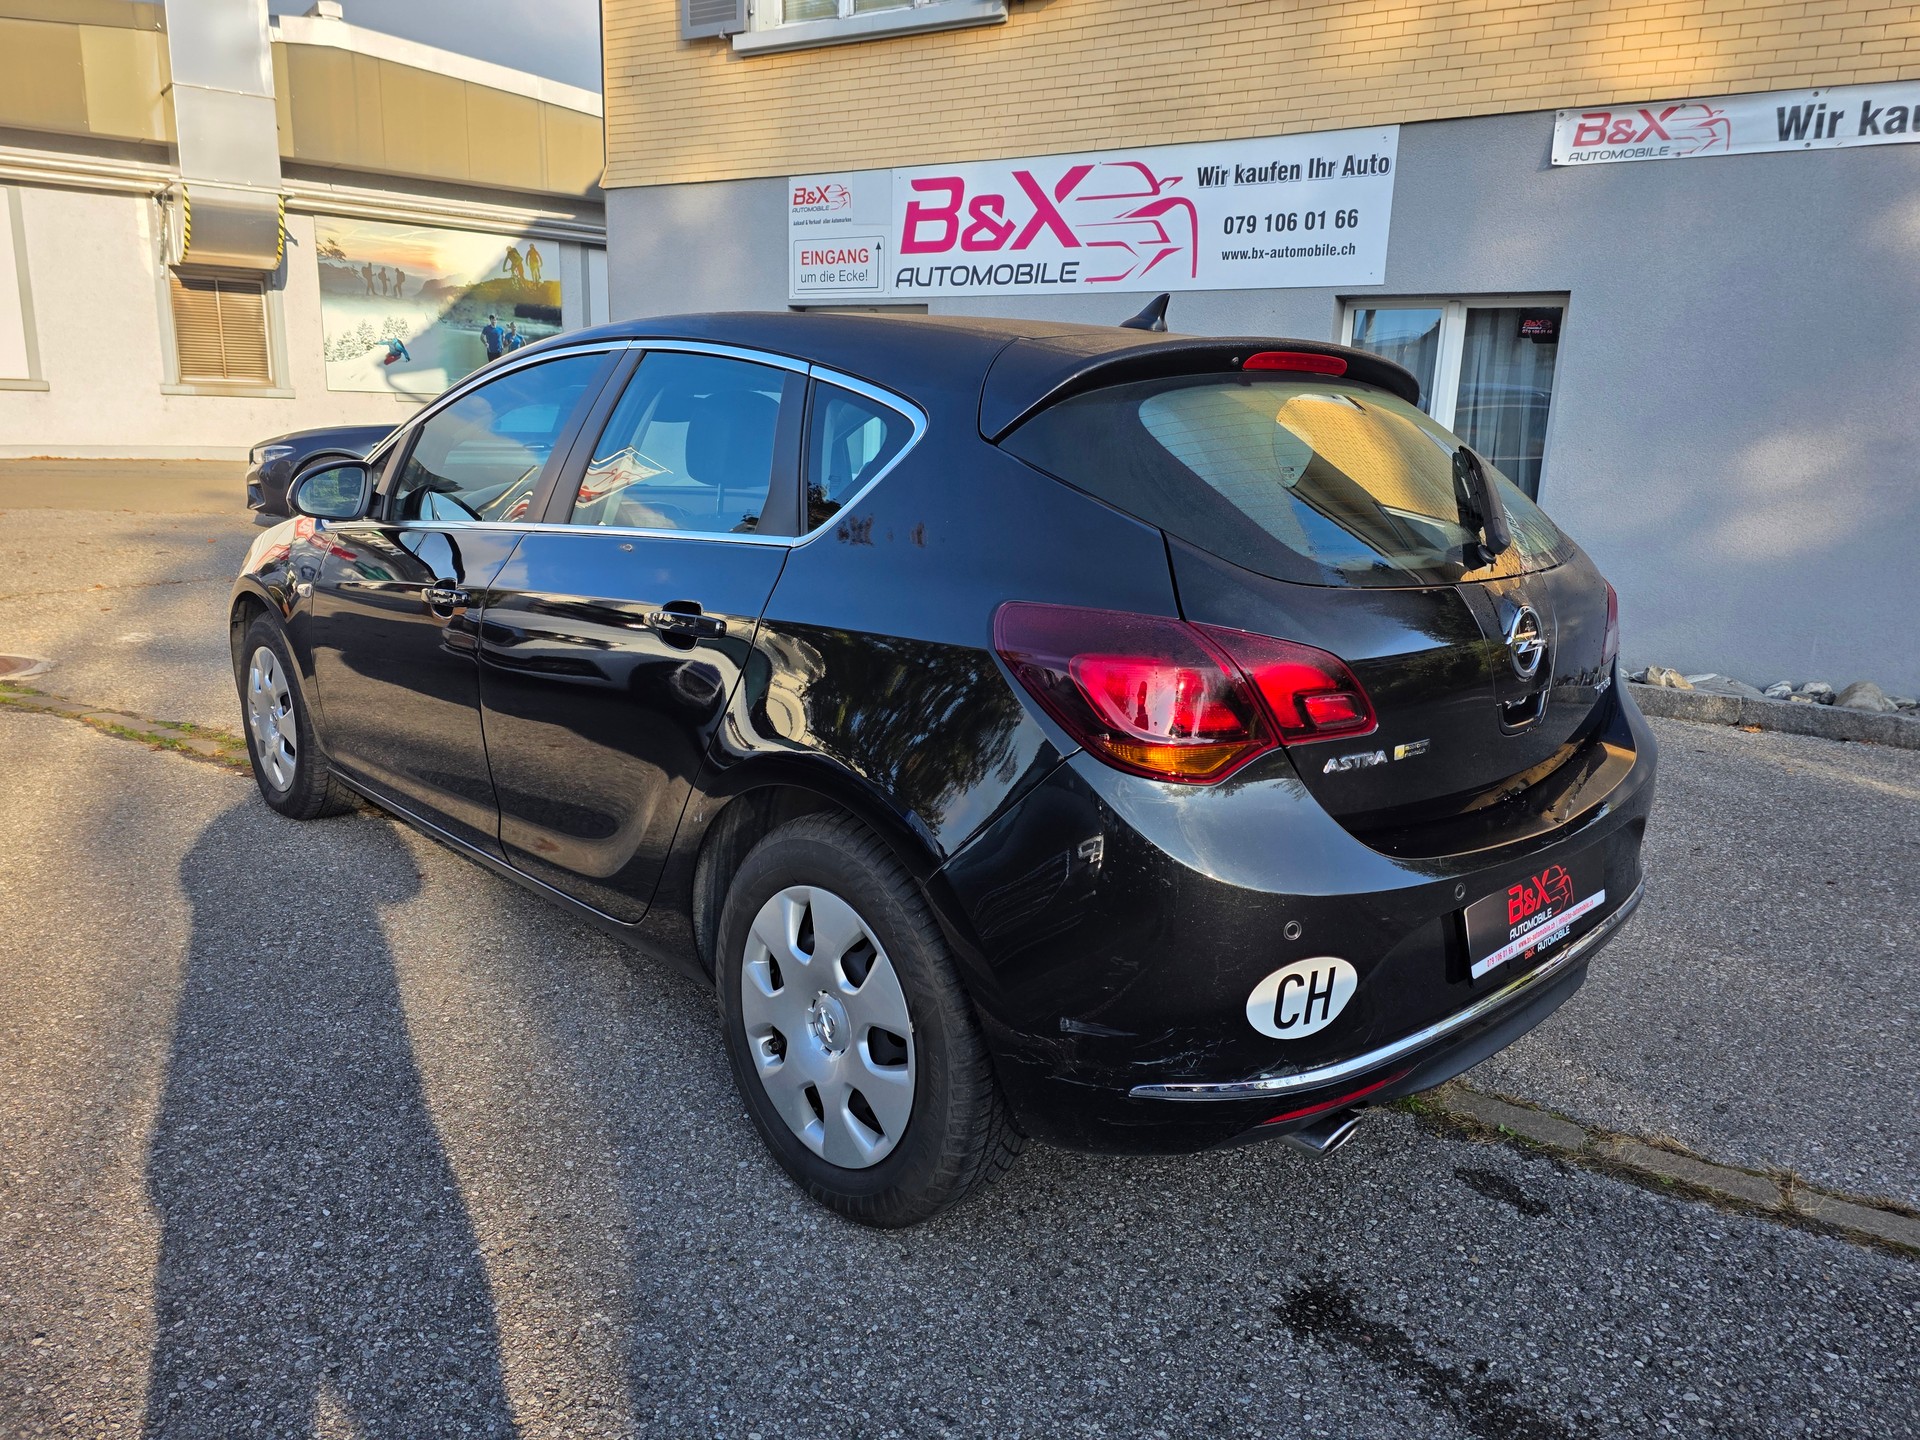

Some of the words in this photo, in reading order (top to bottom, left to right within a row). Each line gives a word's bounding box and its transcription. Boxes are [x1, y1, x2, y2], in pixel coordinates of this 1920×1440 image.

[1572, 106, 1680, 147] B&X
[1776, 103, 1845, 142] Wir
[1568, 146, 1670, 162] AUTOMOBILE
[1197, 165, 1229, 187] Wir
[1234, 161, 1301, 184] kaufen
[1308, 157, 1336, 180] Ihr
[1341, 153, 1390, 177] Auto
[793, 184, 831, 206] B&X
[792, 205, 830, 213] AUTOMOBILE
[900, 164, 1095, 254] B&X
[1223, 215, 1257, 235] 079
[1264, 212, 1298, 232] 106
[1304, 210, 1326, 231] 01
[1334, 208, 1359, 229] 66
[801, 248, 869, 266] EINGANG
[1221, 243, 1356, 260] www.bx-automobile.ch
[800, 273, 816, 283] um
[820, 270, 835, 283] die
[839, 269, 868, 282] Ecke!
[896, 261, 1080, 288] AUTOMOBILE
[1323, 750, 1388, 774] ASTRA
[1508, 869, 1551, 925] B&X
[1509, 907, 1552, 940] AUTOMOBILE
[1537, 925, 1570, 952] AUTOMOBILE
[1273, 966, 1336, 1030] CH
